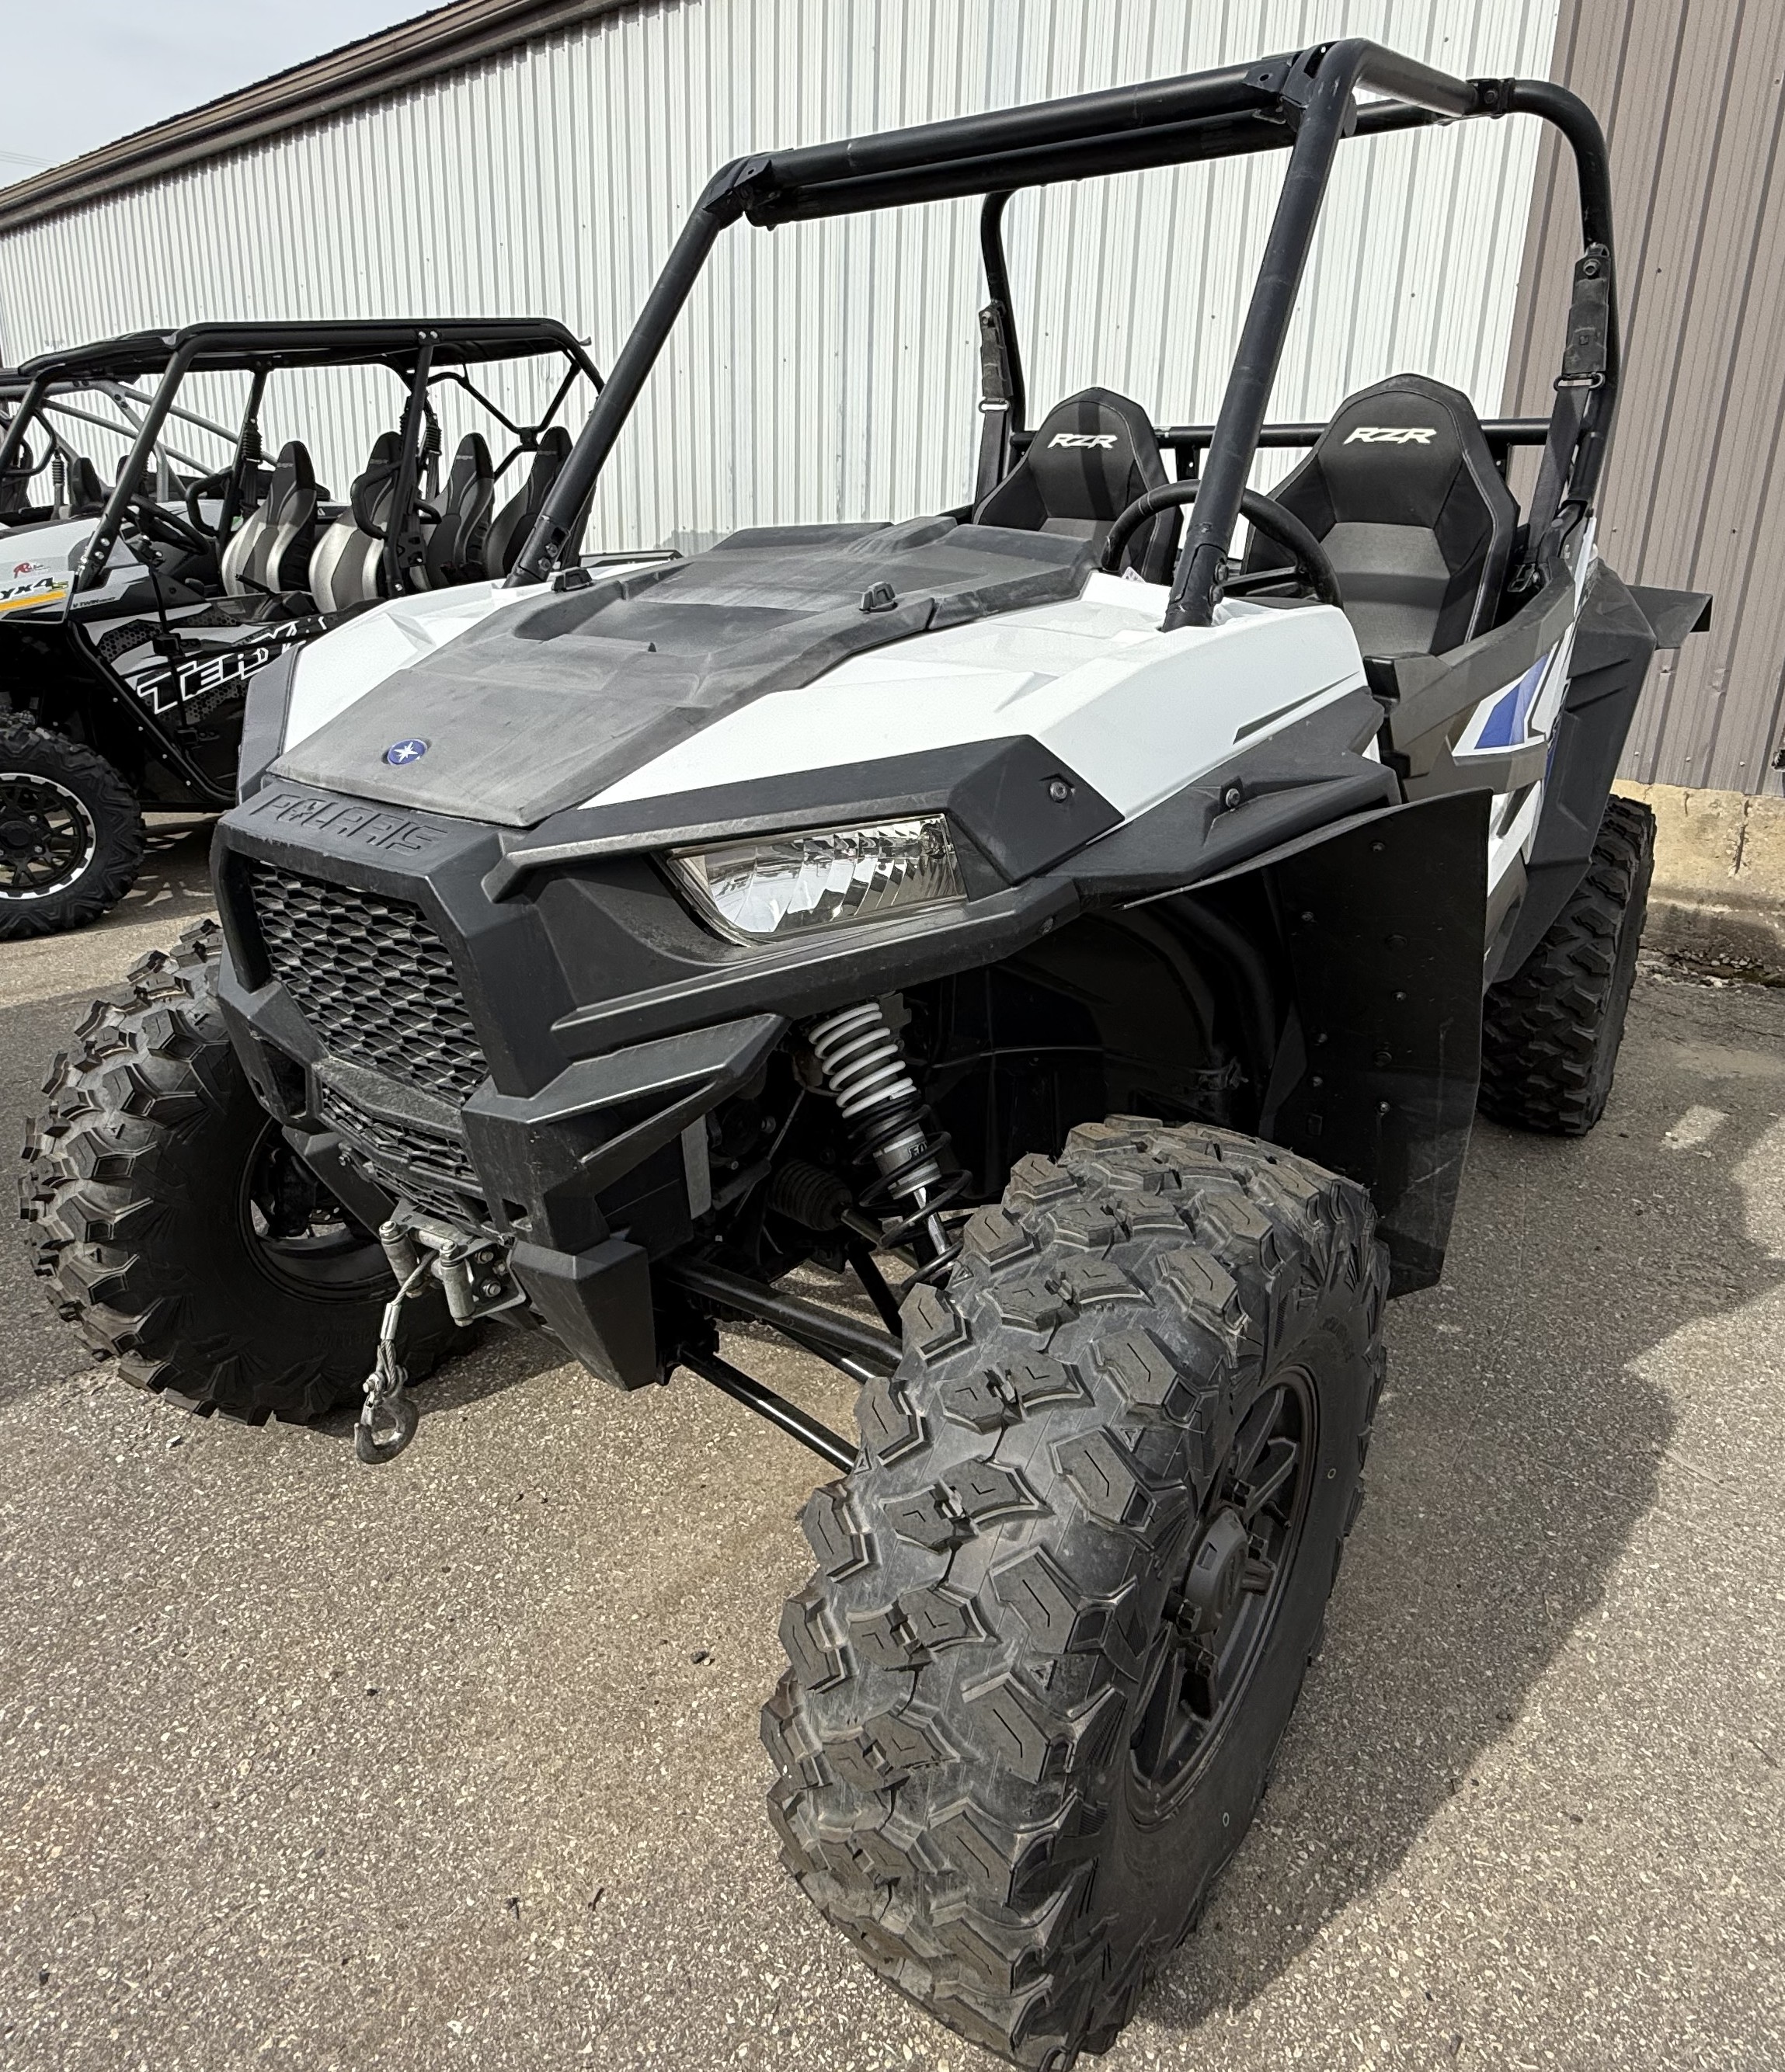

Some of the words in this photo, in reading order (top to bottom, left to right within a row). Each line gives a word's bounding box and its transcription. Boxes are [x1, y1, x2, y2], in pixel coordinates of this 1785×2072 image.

[1047, 433, 1118, 449] RZR
[1343, 428, 1437, 445] RZR
[249, 793, 449, 851] POLARIS
[908, 1141, 929, 1161] FO
